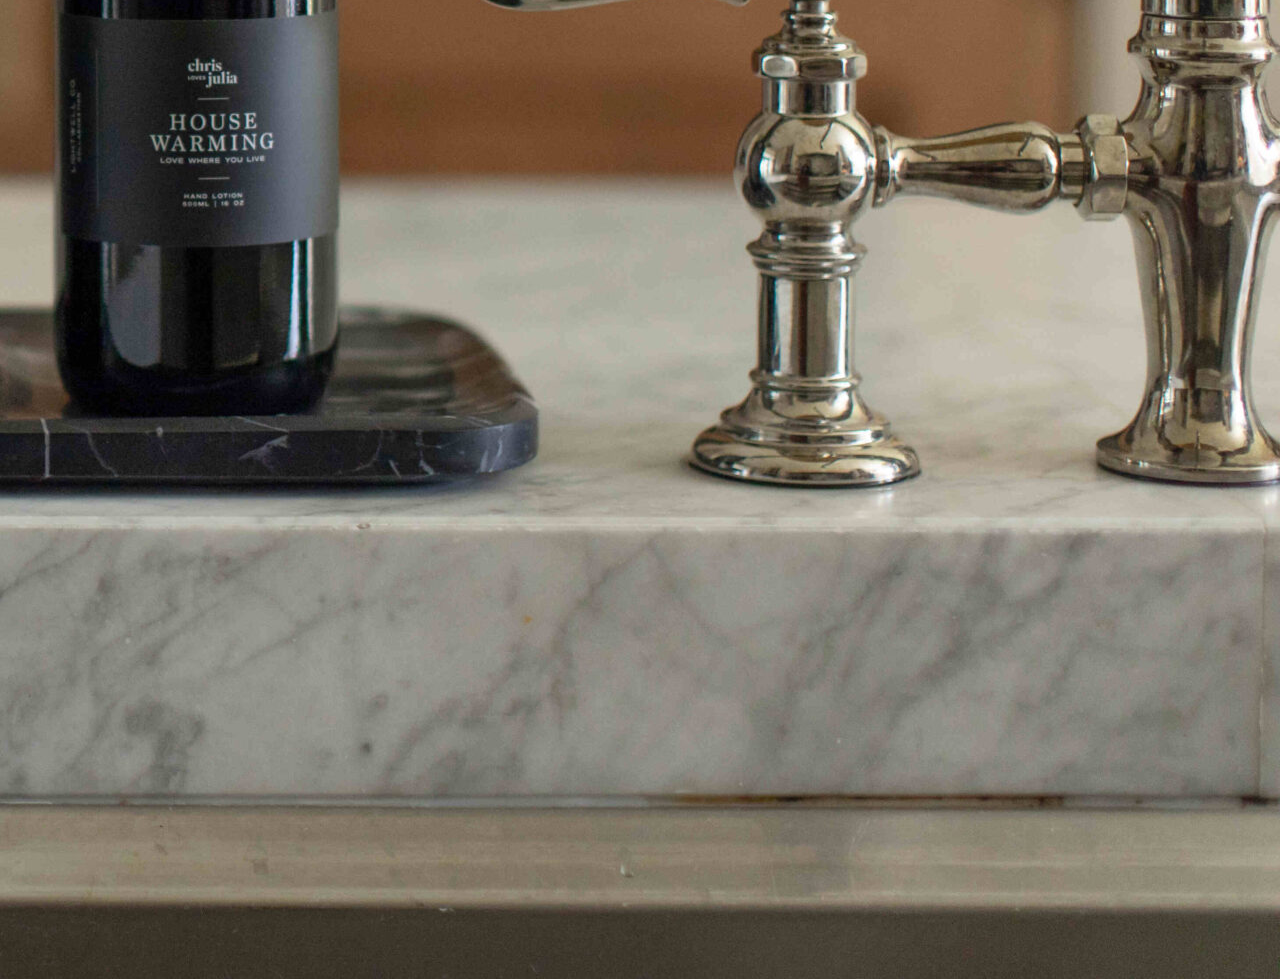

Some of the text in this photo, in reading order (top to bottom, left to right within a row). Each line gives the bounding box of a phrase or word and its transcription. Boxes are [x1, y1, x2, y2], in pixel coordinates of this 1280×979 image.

[187, 58, 222, 72] chris
[205, 71, 239, 88] julia
[169, 112, 258, 131] HOUSE
[150, 132, 276, 152] WARMING
[246, 155, 266, 163] LIVE
